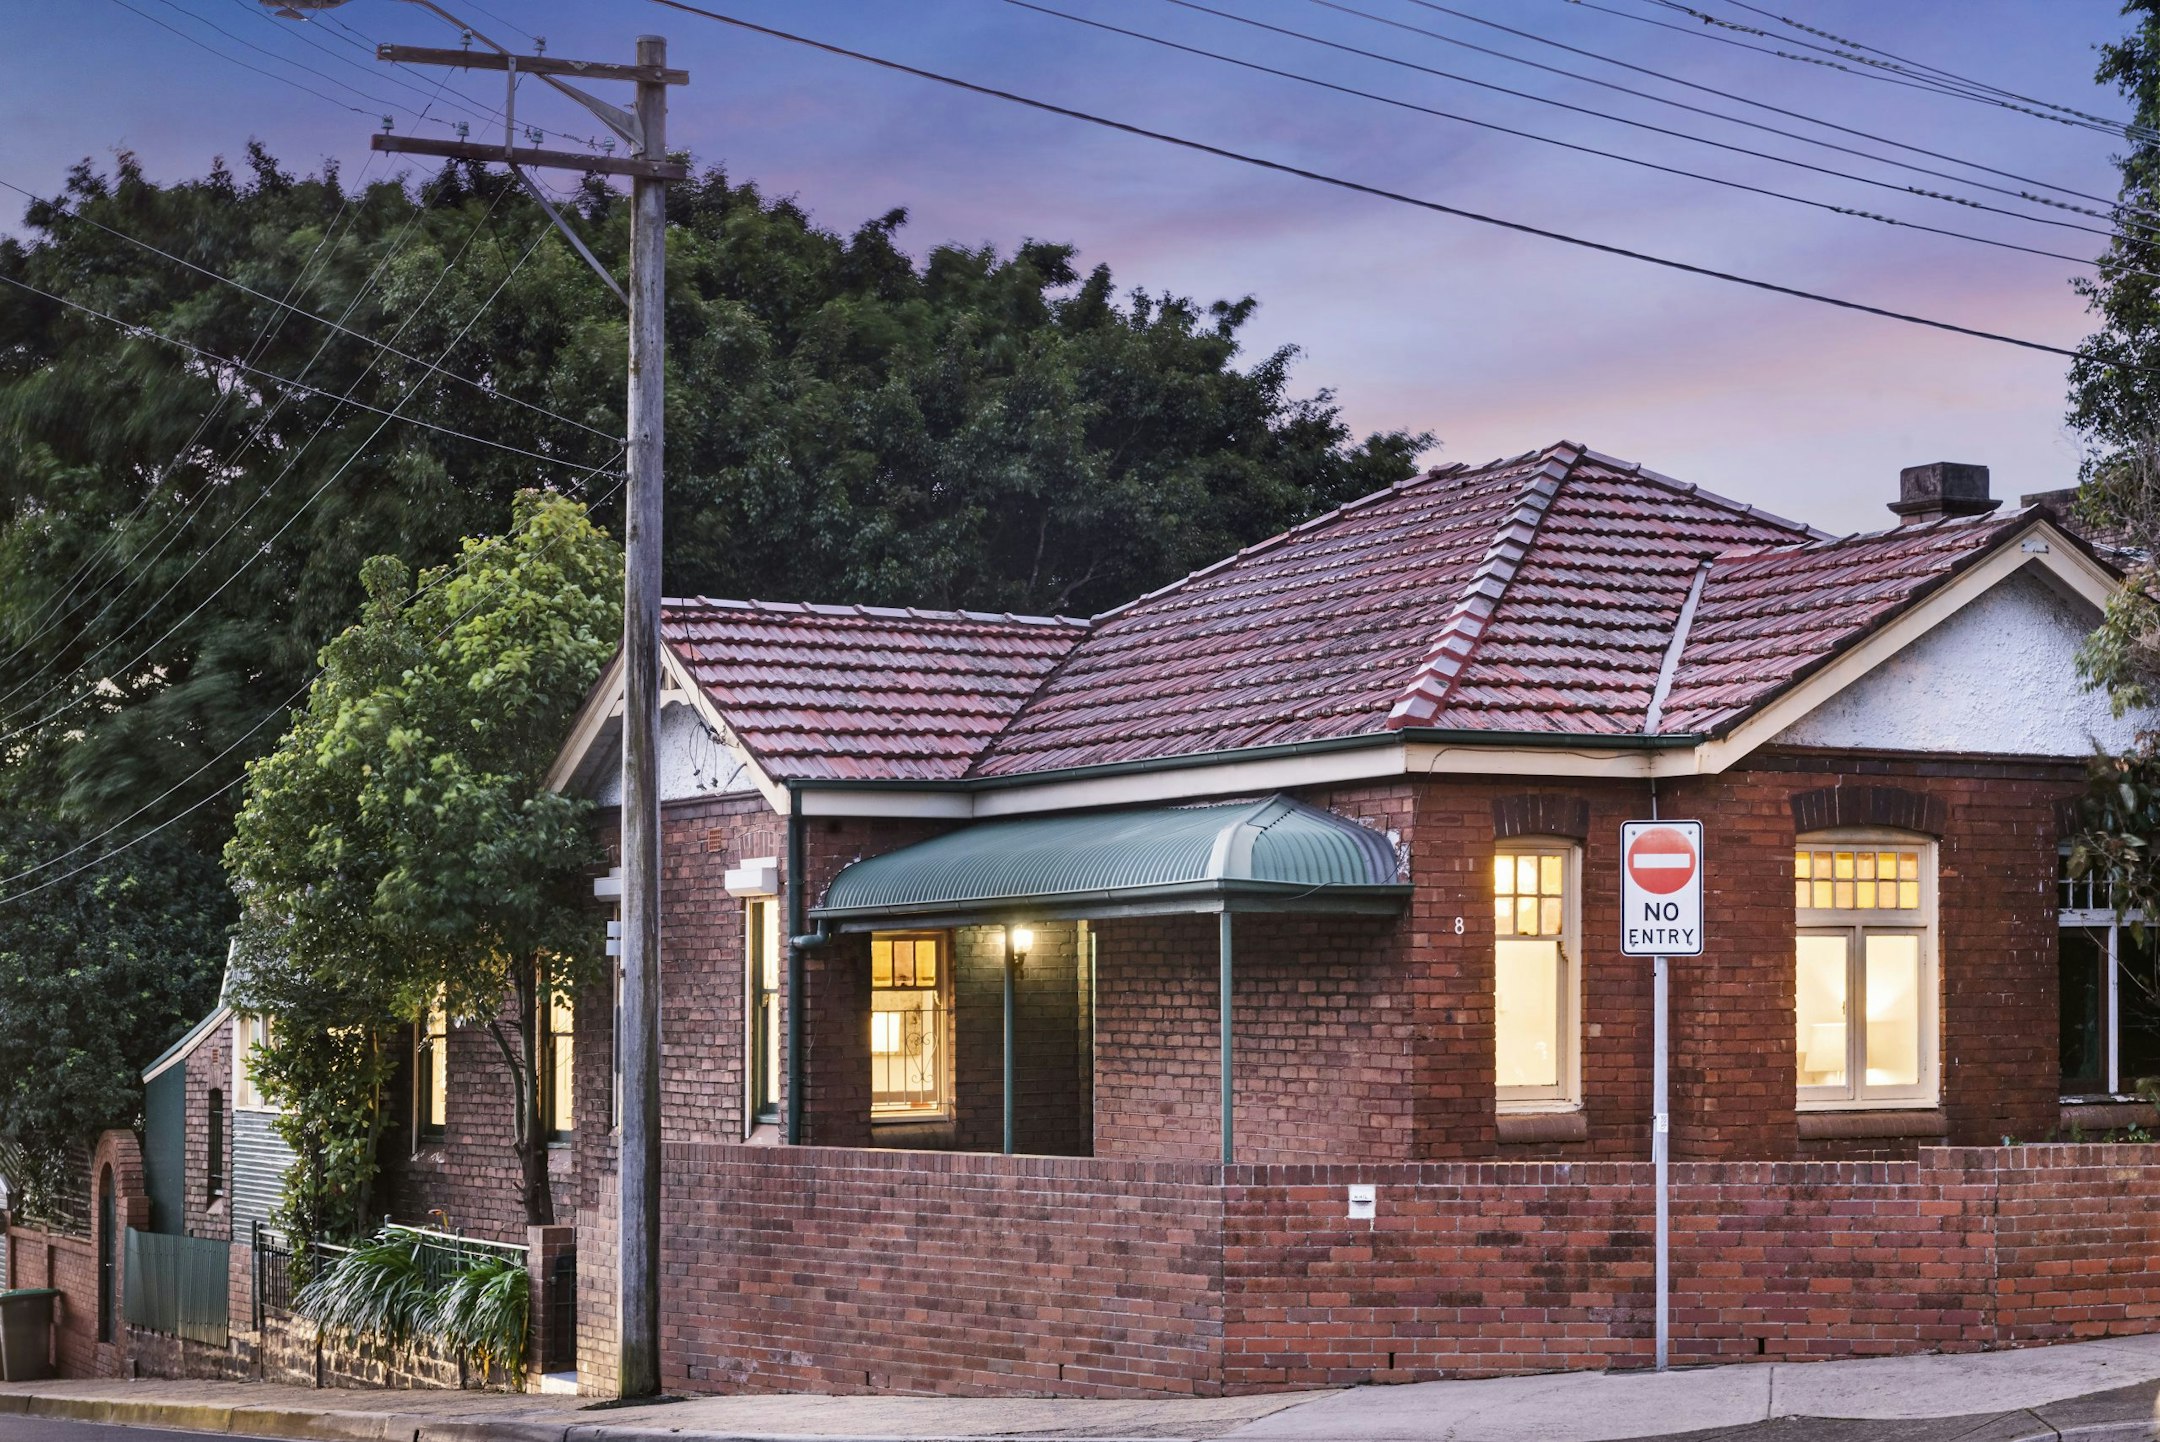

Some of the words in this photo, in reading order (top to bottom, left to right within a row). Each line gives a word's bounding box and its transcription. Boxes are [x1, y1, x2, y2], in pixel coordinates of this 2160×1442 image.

[1644, 902, 1679, 921] NO
[1454, 916, 1465, 935] 8
[1629, 928, 1694, 944] ENTRY
